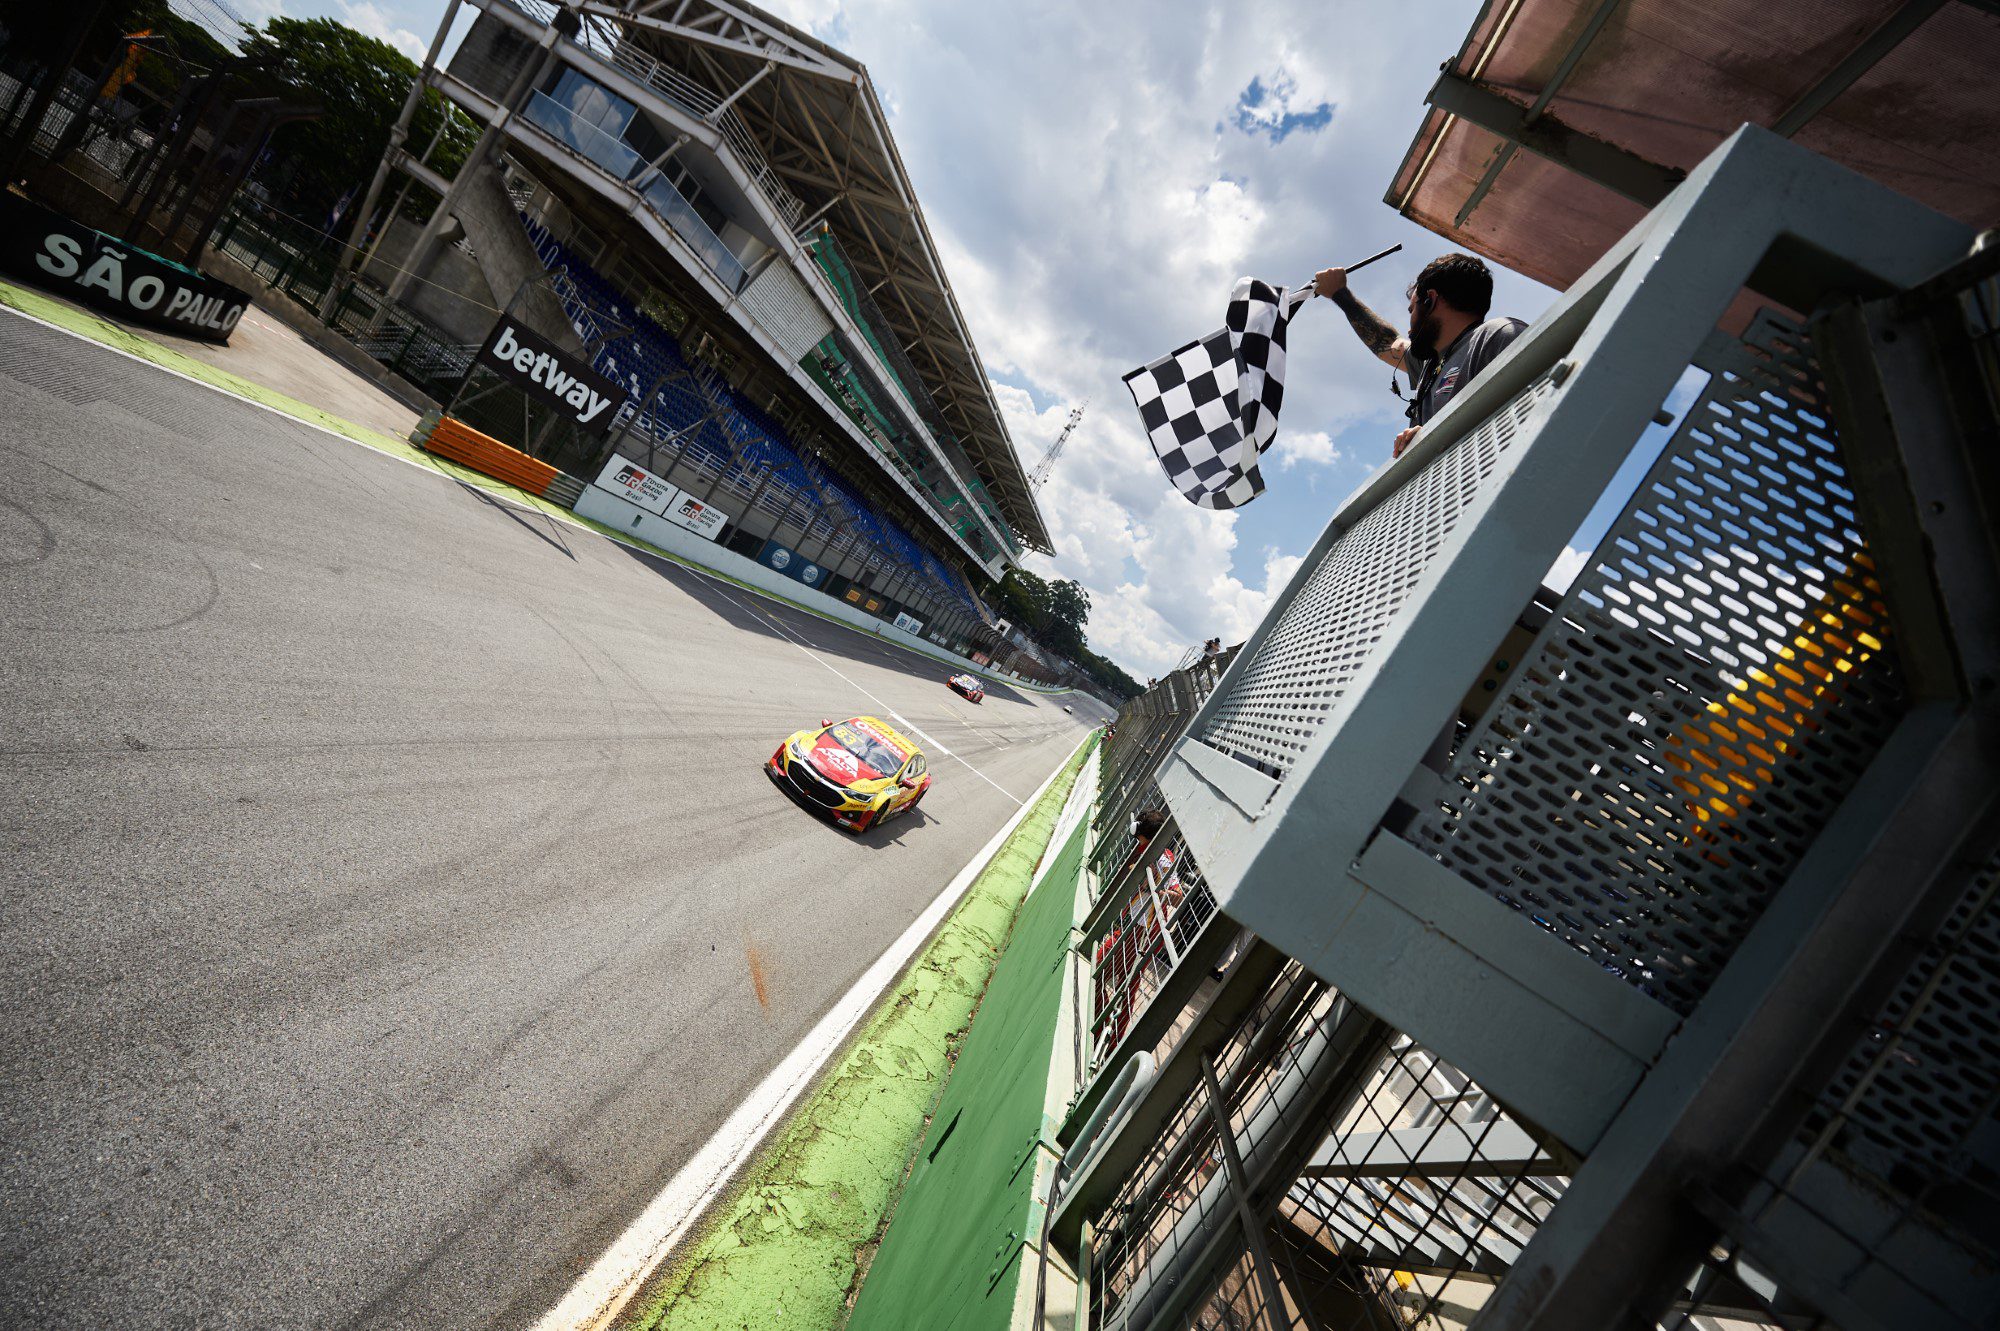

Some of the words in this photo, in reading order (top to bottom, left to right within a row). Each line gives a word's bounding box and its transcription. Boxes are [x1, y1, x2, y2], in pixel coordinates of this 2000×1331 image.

[35, 233, 165, 311] SÃO
[163, 286, 242, 331] PAULO
[492, 326, 611, 423] betway
[614, 471, 640, 489] GR
[625, 490, 643, 501] Brasil
[637, 487, 659, 501] Racing
[679, 504, 700, 520] GR
[833, 729, 857, 745] 83
[816, 748, 858, 779] AXALTA
